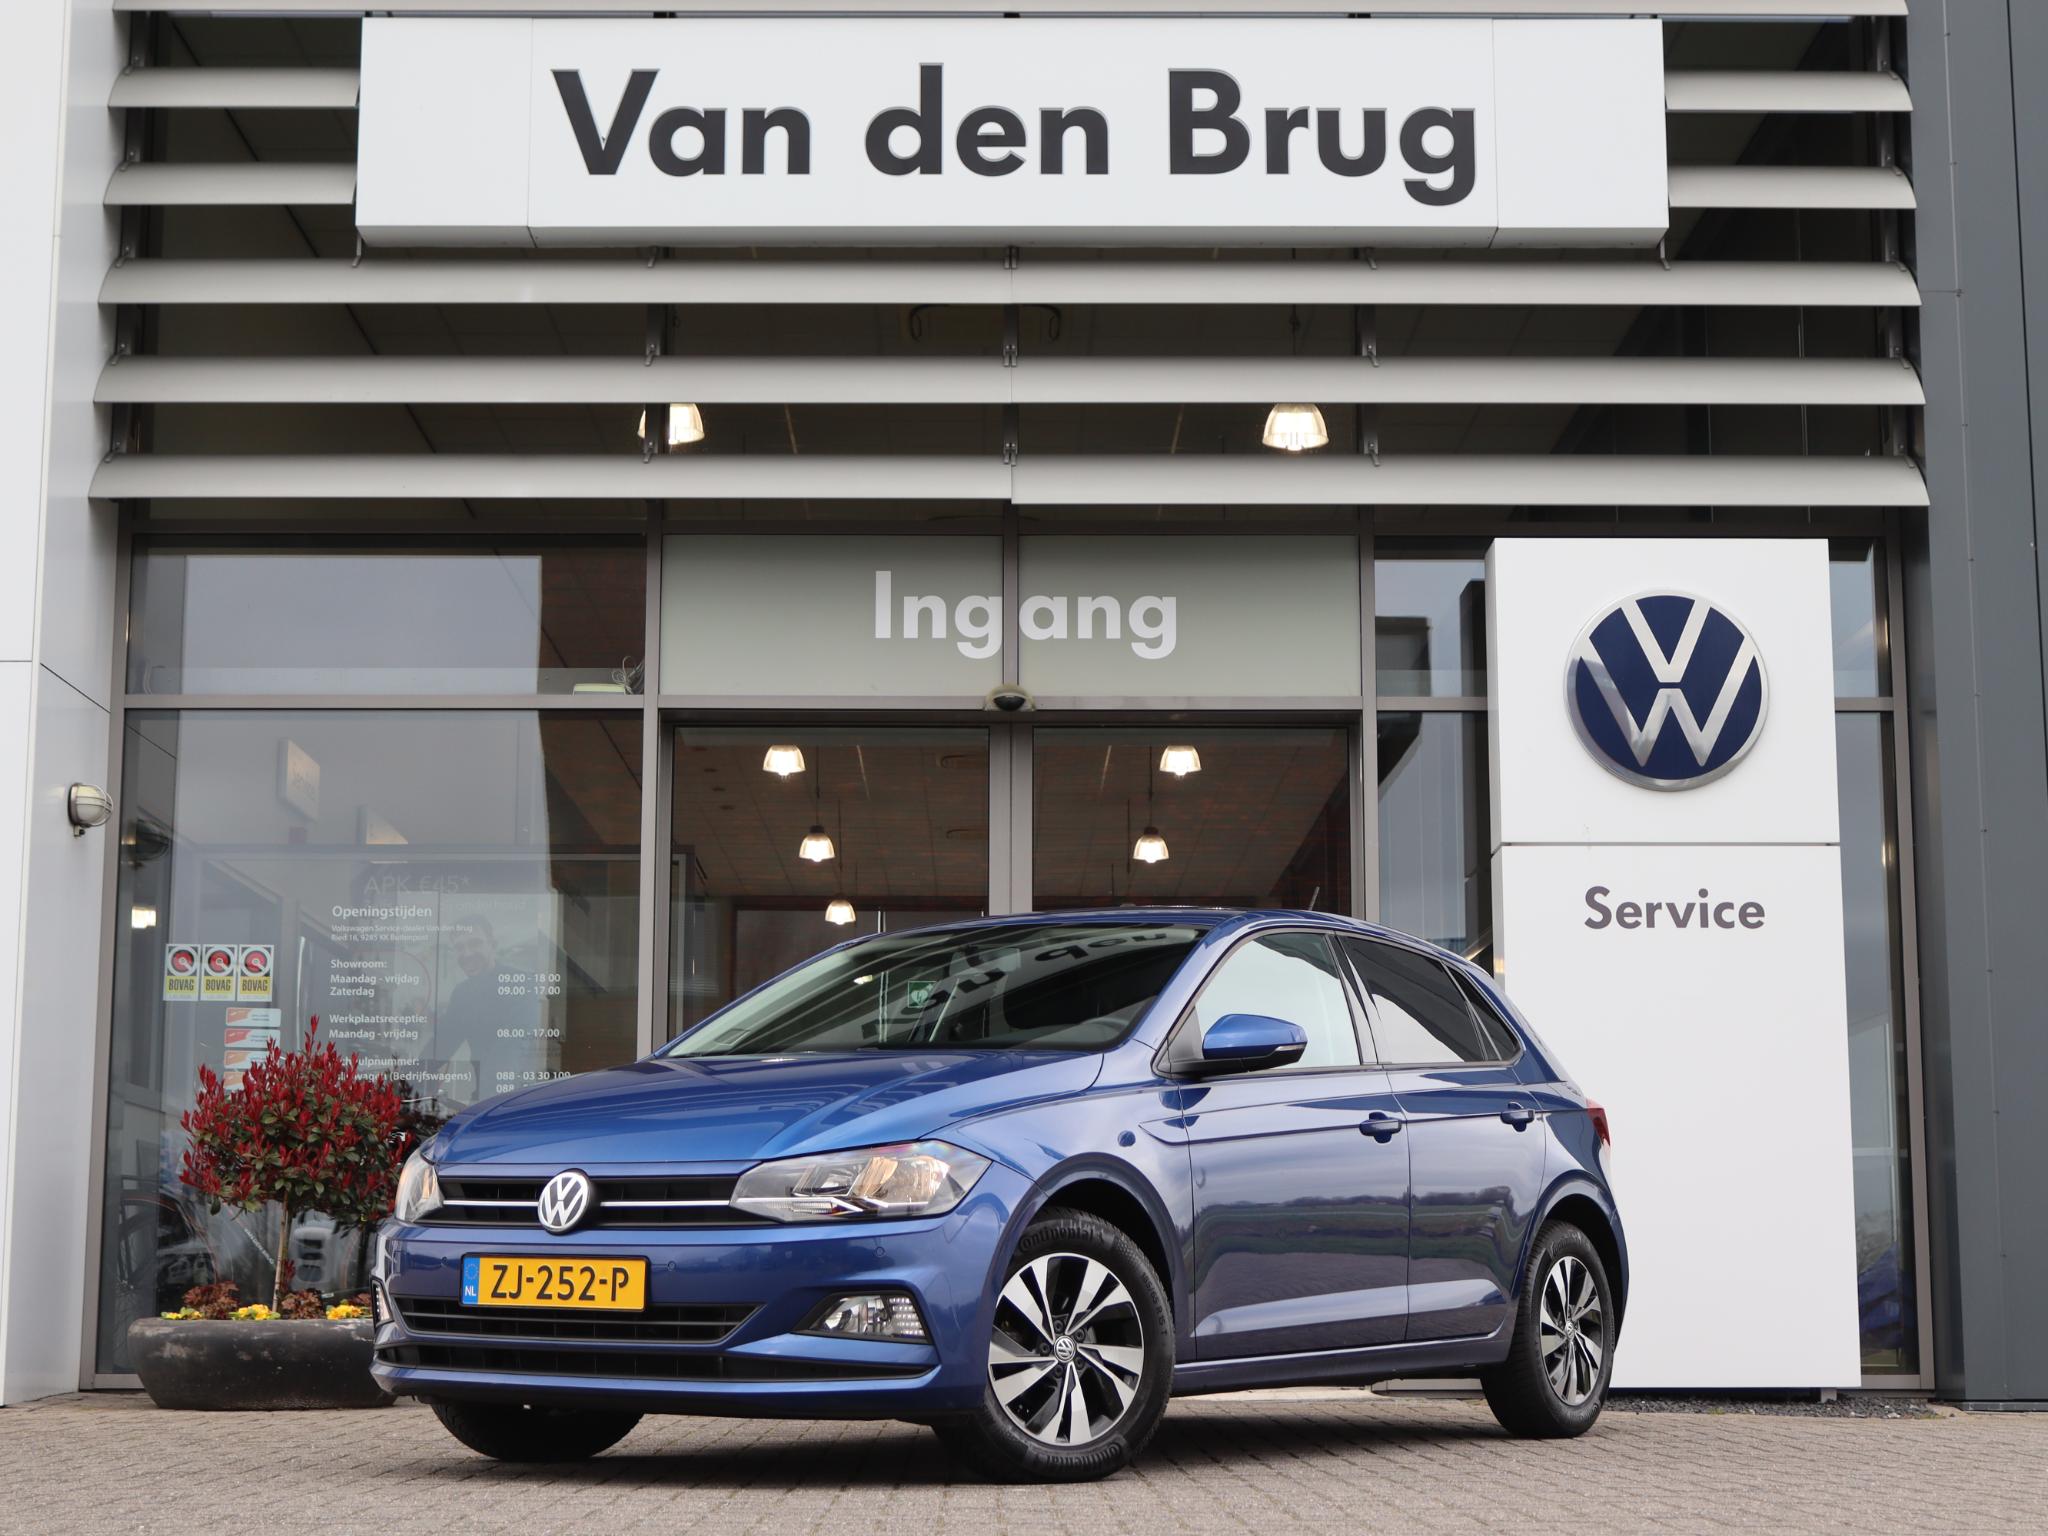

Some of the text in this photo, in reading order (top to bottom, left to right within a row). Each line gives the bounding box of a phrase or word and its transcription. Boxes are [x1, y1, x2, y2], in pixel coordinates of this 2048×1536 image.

[552, 65, 1475, 206] Van den Brug
[875, 569, 1177, 660] Ingang
[332, 904, 433, 919] Openingstijden
[1585, 887, 1764, 929] Service
[330, 959, 387, 969] Showroom:
[330, 974, 377, 985] Maandag
[384, 974, 420, 985] vrijdag
[498, 973, 526, 983] 09.00
[534, 973, 561, 983] 1800
[168, 978, 195, 991] BOVAG
[205, 978, 231, 992] BOVAG
[242, 979, 268, 992] BOVAG
[330, 986, 375, 998] Zaterdag
[498, 986, 526, 995] 09.00
[329, 1014, 428, 1025] Werkplaatsreceptie:
[329, 1029, 376, 1040] Maandag
[383, 1029, 418, 1040] vrijdag
[497, 1029, 525, 1038] 08.00
[533, 1029, 560, 1038] 17.00
[390, 1072, 472, 1083] (Bedrijfswagens)
[523, 1071, 535, 1080] 03
[537, 1071, 550, 1080] 30
[464, 1264, 629, 1302] NL ZJ-252-P
